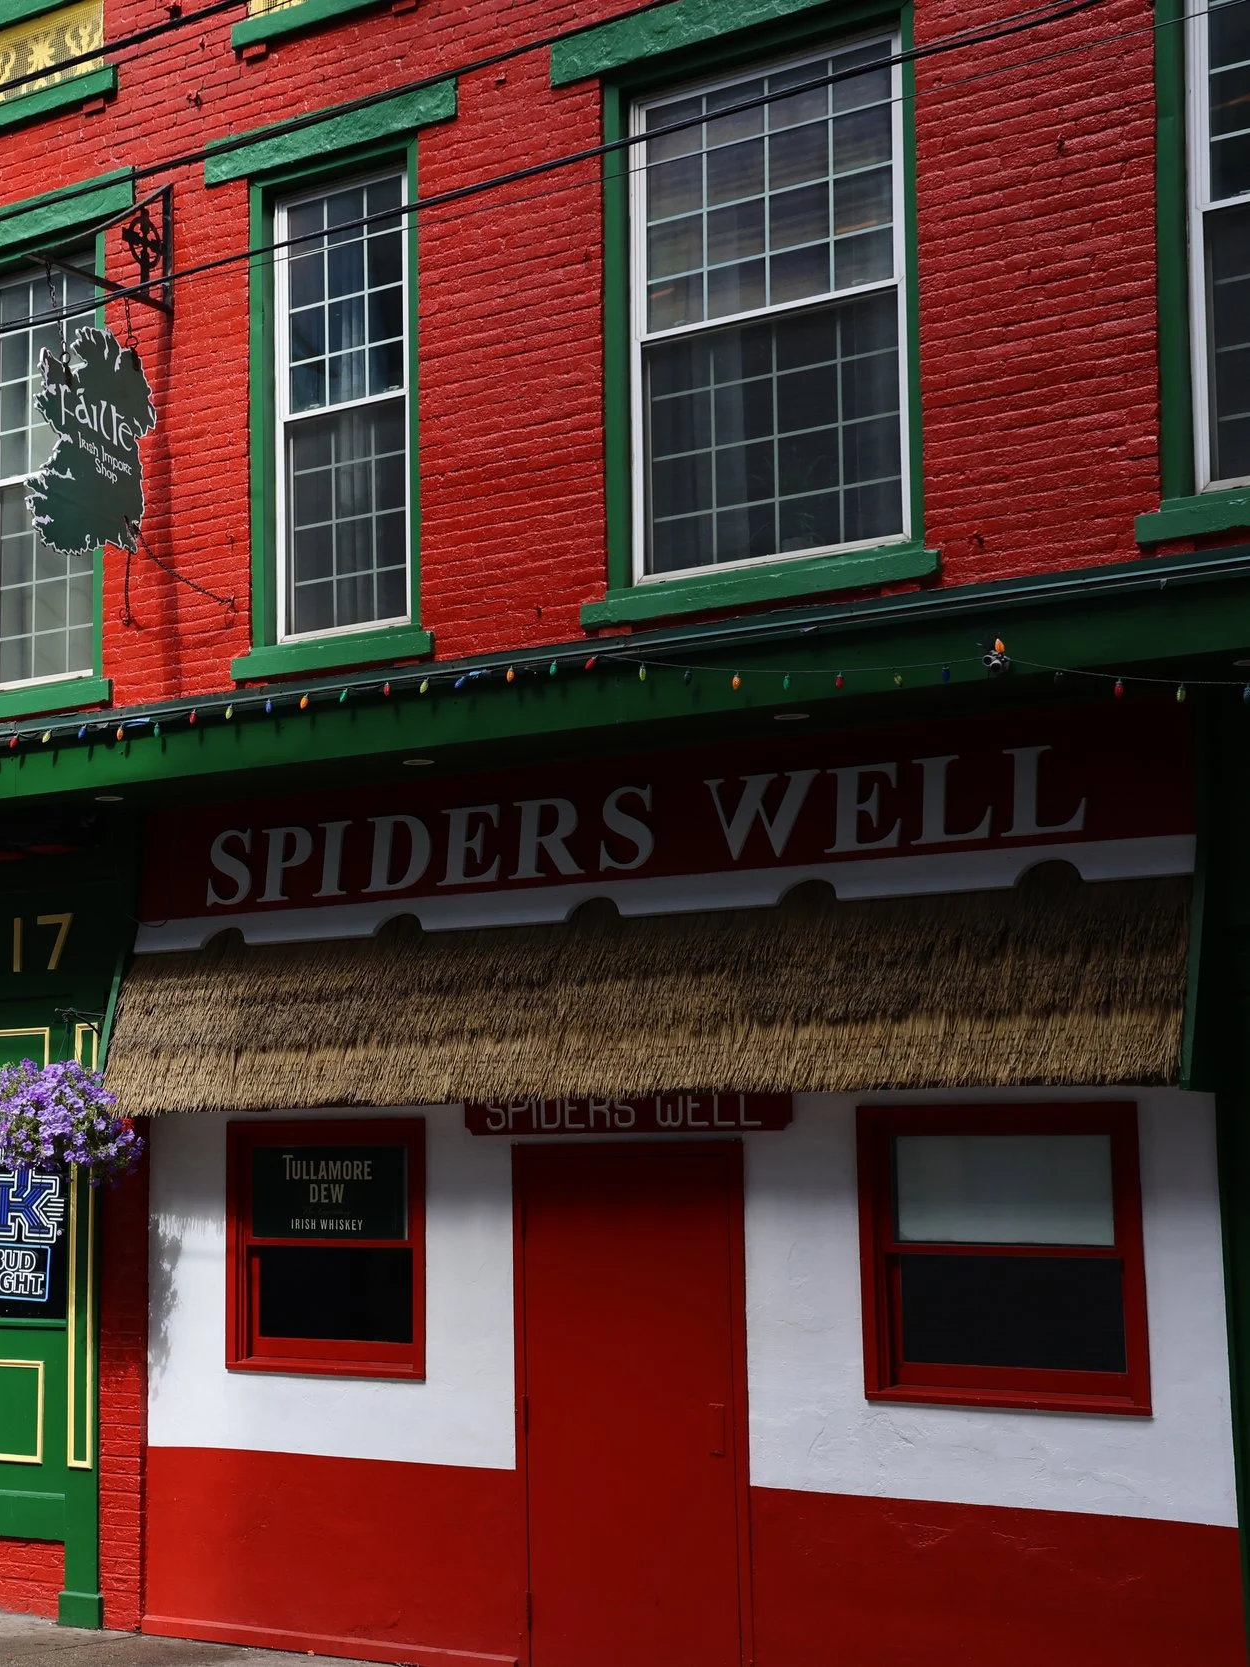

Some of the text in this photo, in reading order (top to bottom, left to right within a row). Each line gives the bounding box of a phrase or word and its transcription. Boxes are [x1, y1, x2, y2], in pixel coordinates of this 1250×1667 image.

[78, 431, 99, 457] Irish
[94, 458, 118, 484] Shop
[205, 744, 1088, 908] SPIDERS WELL
[485, 1094, 763, 1132] SPIDERS WELL
[282, 1154, 373, 1180] TULLAMORE
[309, 1183, 345, 1203] DEW
[291, 1218, 363, 1231] IRISH WHISKEY
